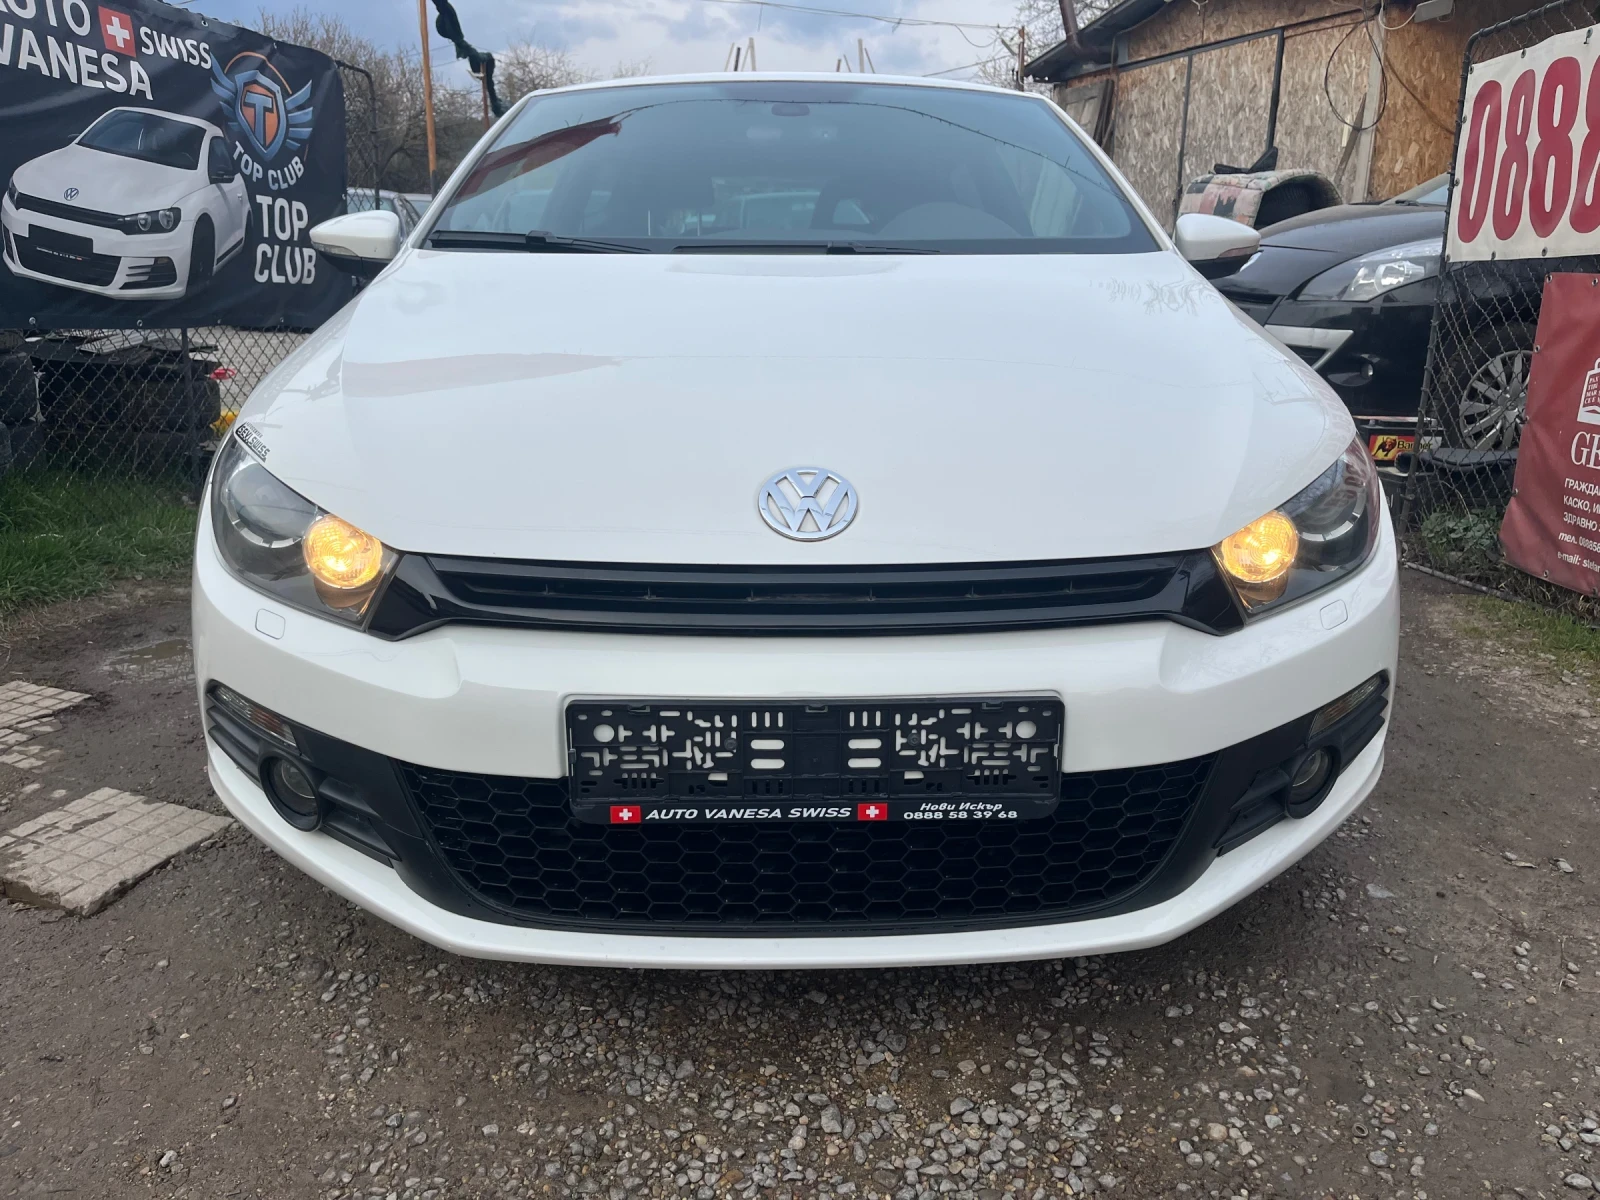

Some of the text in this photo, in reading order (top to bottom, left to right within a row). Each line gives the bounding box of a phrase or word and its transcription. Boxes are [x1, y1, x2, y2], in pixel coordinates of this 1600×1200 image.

[0, 0, 91, 37] TO
[139, 26, 212, 70] SWISS
[233, 141, 304, 190] TOP CLUB
[256, 195, 308, 241] TOP
[254, 243, 316, 284] CLUB
[1564, 478, 1600, 496] ГРАЖДА
[1563, 495, 1600, 514] КАСКО, И
[1563, 511, 1597, 531] ЗДРАВНО
[1557, 551, 1581, 565] e-mail:
[645, 807, 852, 820] AUTO VANESA SWISS
[903, 810, 1018, 820] 0888 58 39 68
[920, 802, 1003, 812] Нови Искър
